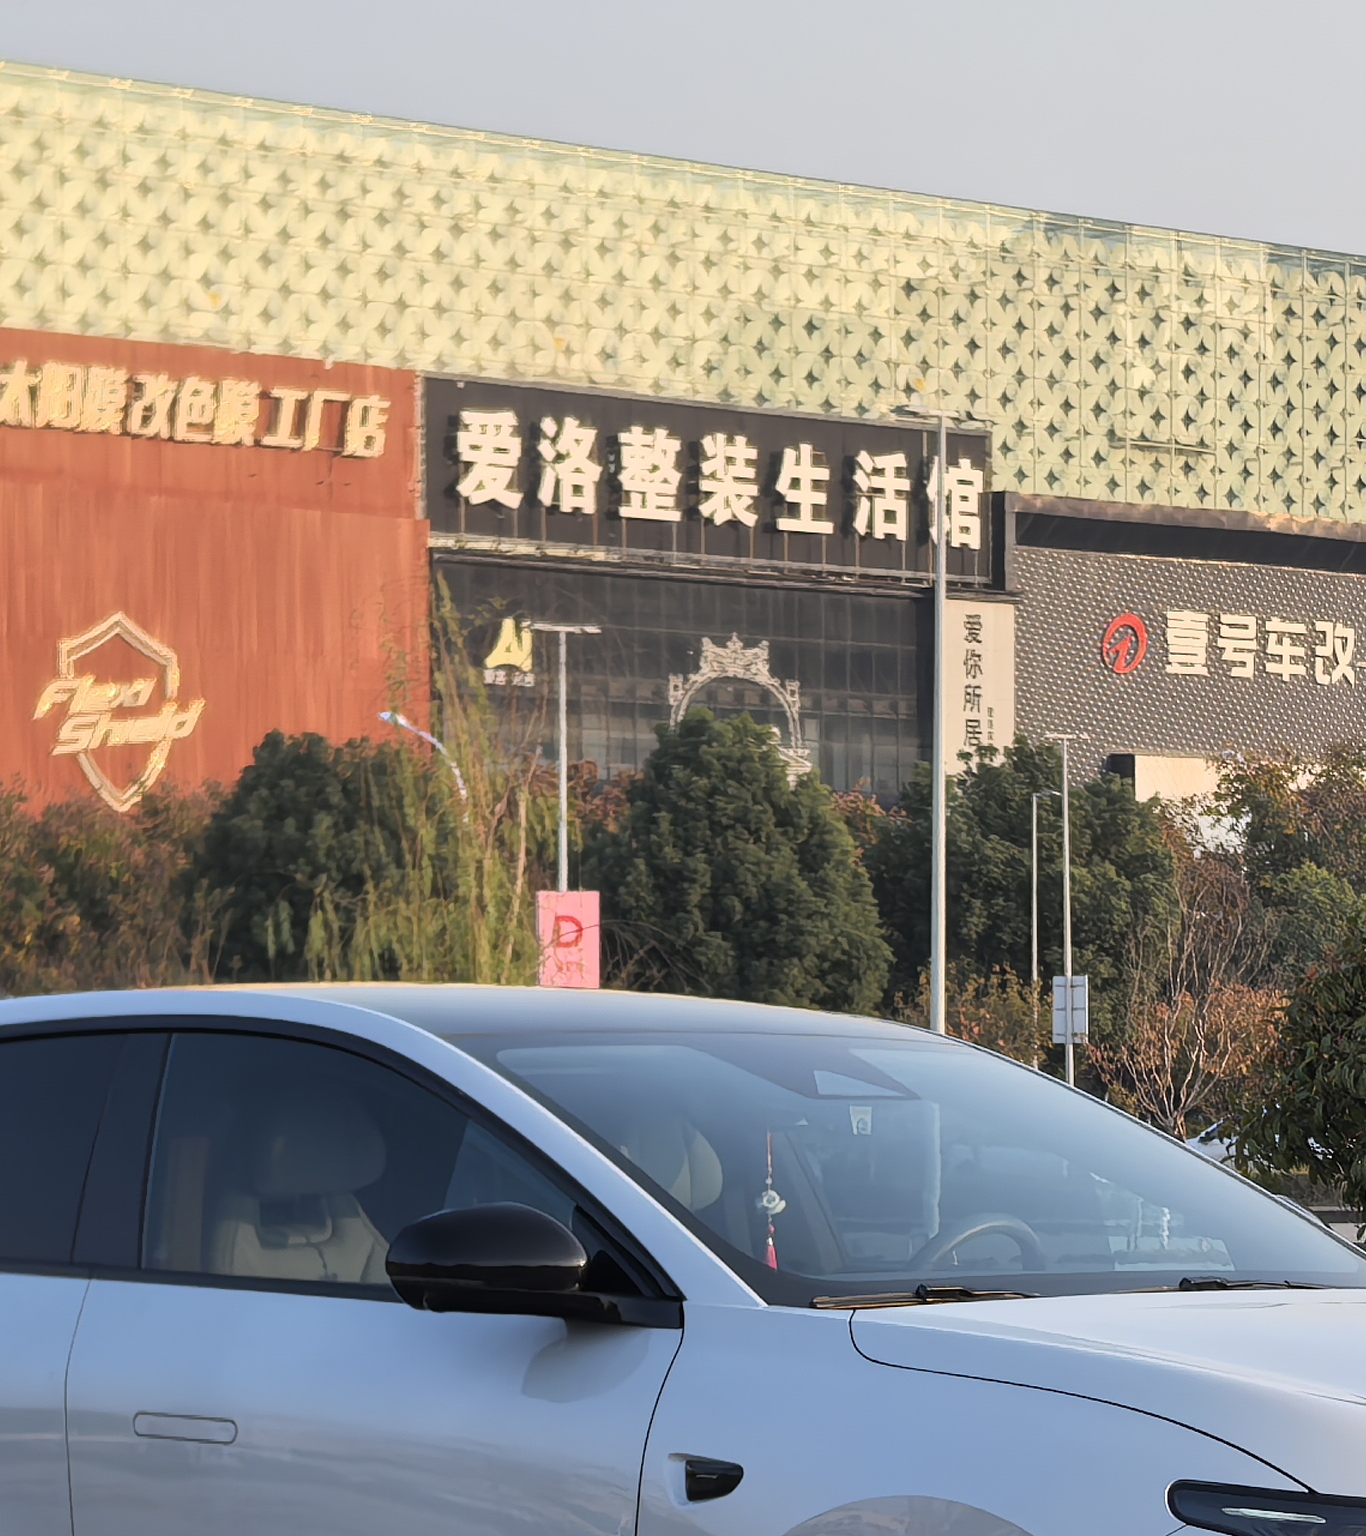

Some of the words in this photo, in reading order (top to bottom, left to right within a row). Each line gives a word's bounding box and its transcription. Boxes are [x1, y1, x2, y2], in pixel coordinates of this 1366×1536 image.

[455, 408, 984, 551] 爱洛整装生活馆
[1165, 607, 1356, 688] 壹号车改
[554, 915, 584, 948] D
